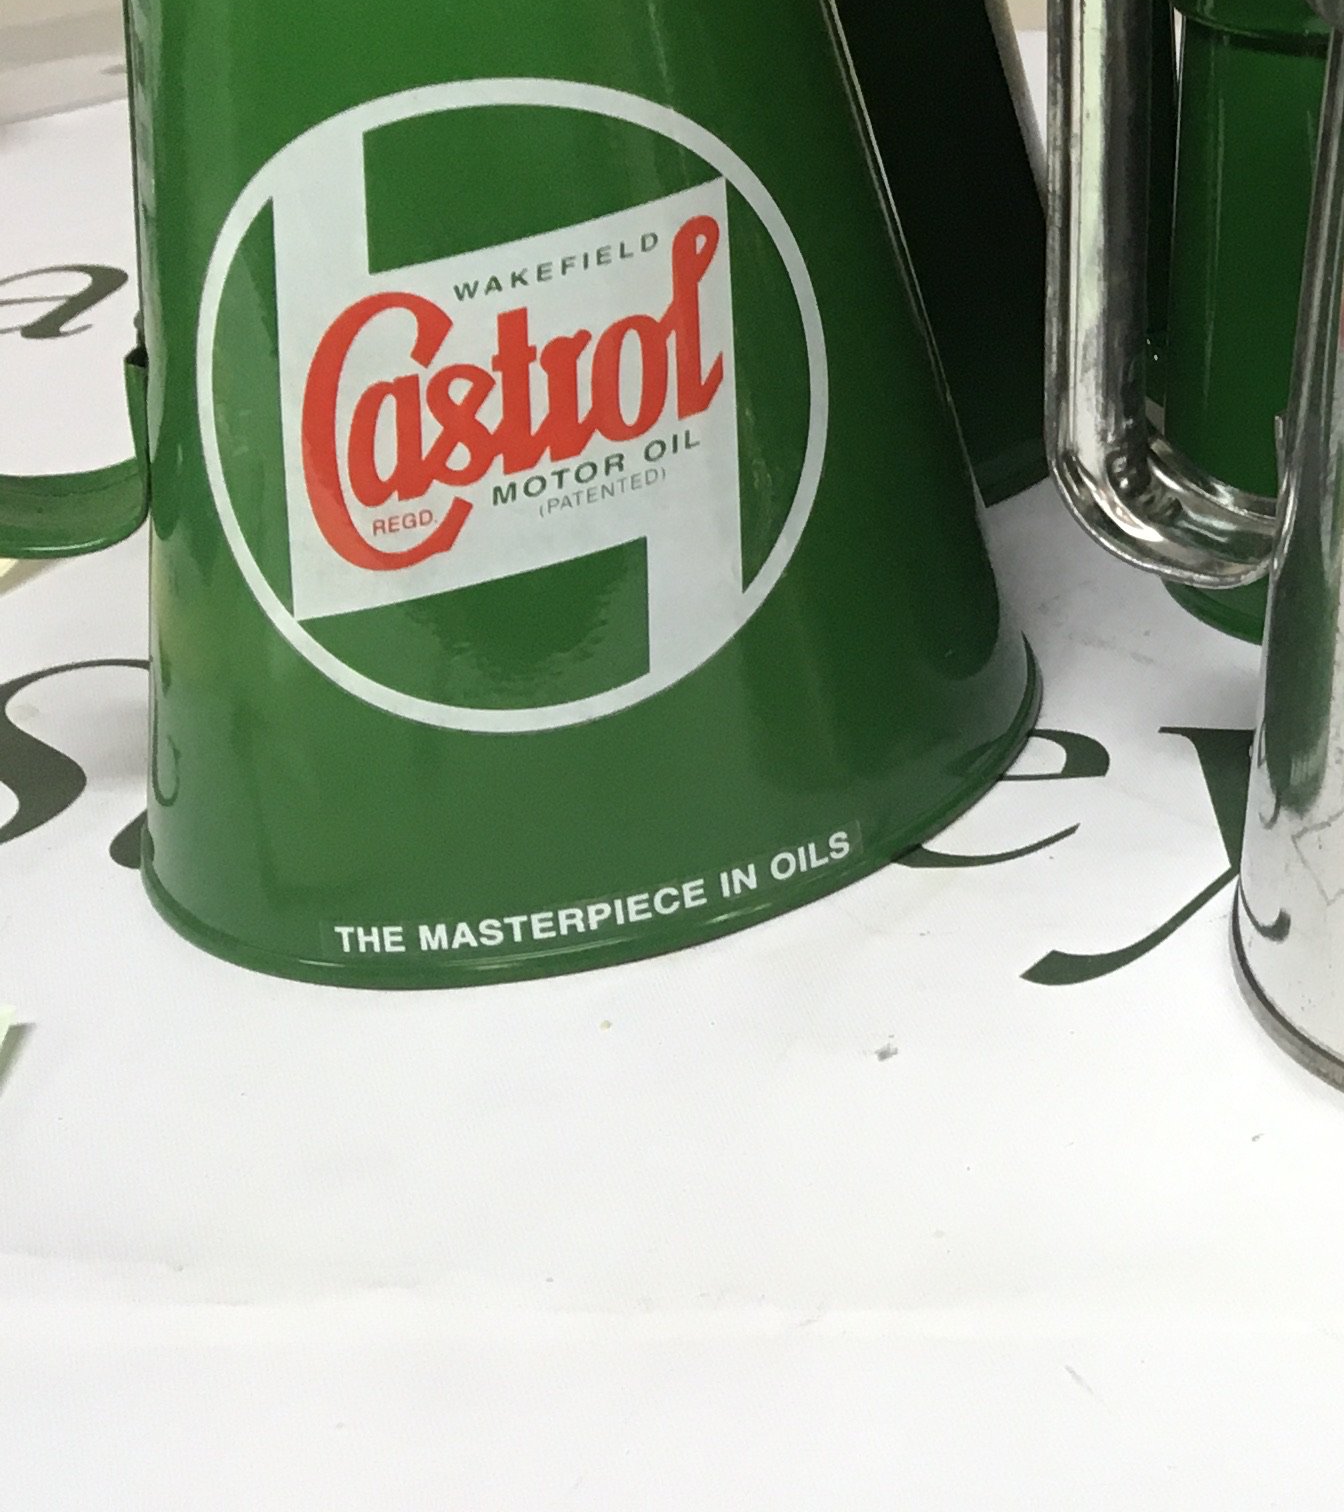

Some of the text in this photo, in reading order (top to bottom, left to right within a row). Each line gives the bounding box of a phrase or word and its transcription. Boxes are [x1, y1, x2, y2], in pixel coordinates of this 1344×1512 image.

[453, 232, 660, 301] WAKEFIELD
[301, 215, 724, 571] Castrol
[492, 430, 700, 506] MOTOR OIL
[539, 466, 667, 518] (PATENTED)
[334, 830, 851, 953] THE MASTERPIECE IN OILS
